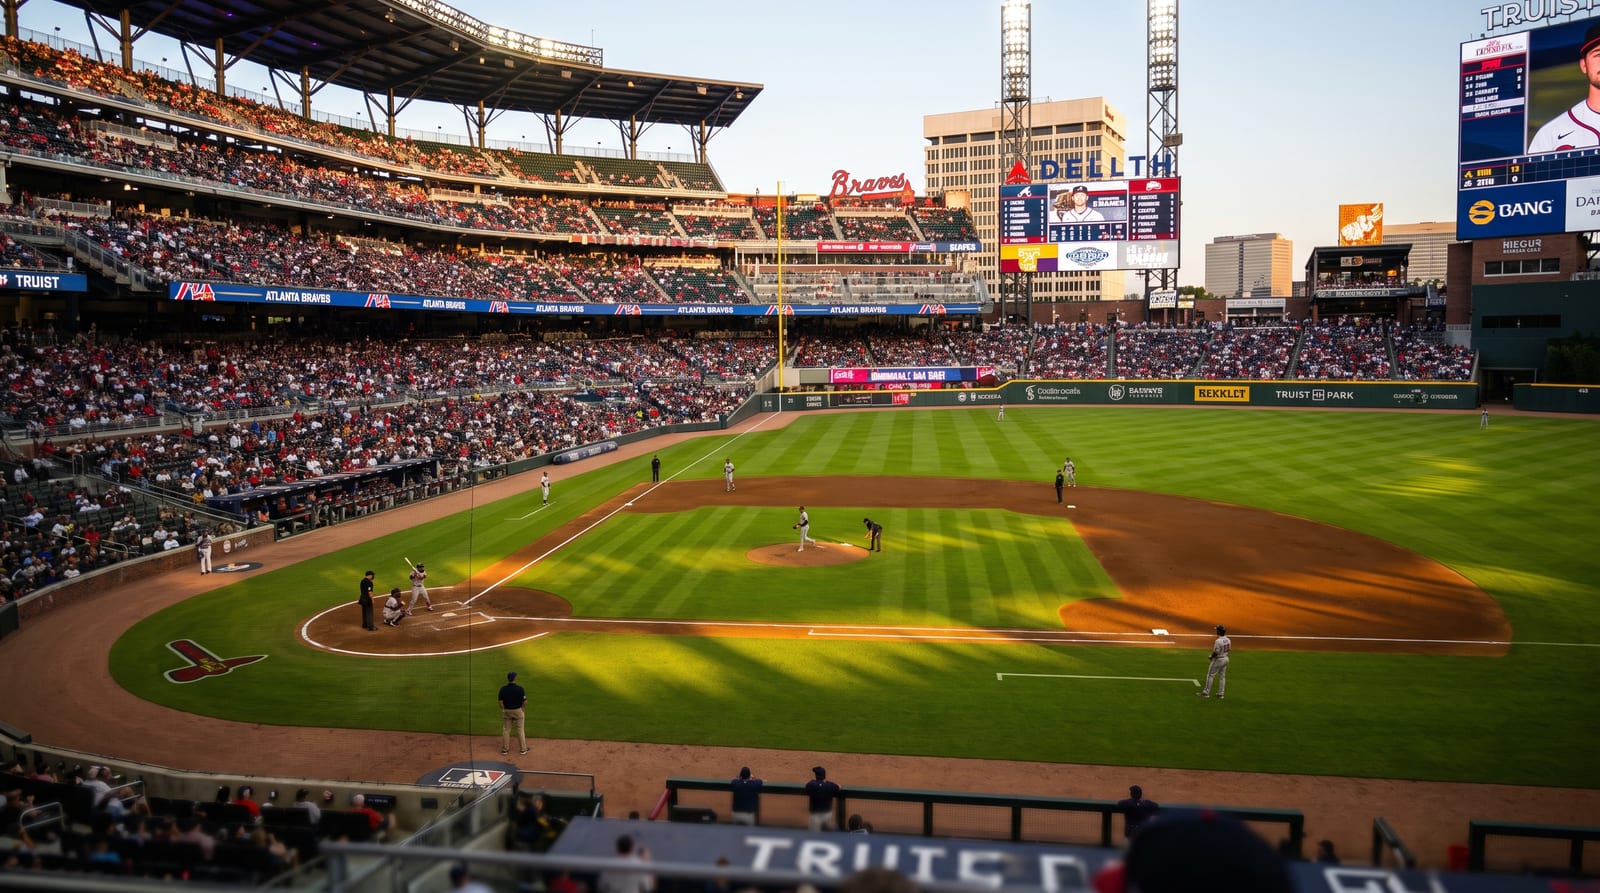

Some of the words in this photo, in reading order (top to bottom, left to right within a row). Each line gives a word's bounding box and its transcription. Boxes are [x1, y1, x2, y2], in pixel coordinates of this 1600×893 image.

[828, 169, 905, 201] Braves
[1498, 199, 1553, 217] BANG
[15, 274, 60, 289] TRUIST
[265, 290, 300, 302] ATLANTA
[422, 299, 445, 309] ATLANTA
[535, 304, 559, 313] ATLANTA
[677, 306, 706, 314] ATLANTA
[1275, 390, 1311, 399] TRUIST
[1326, 391, 1354, 400] PARK
